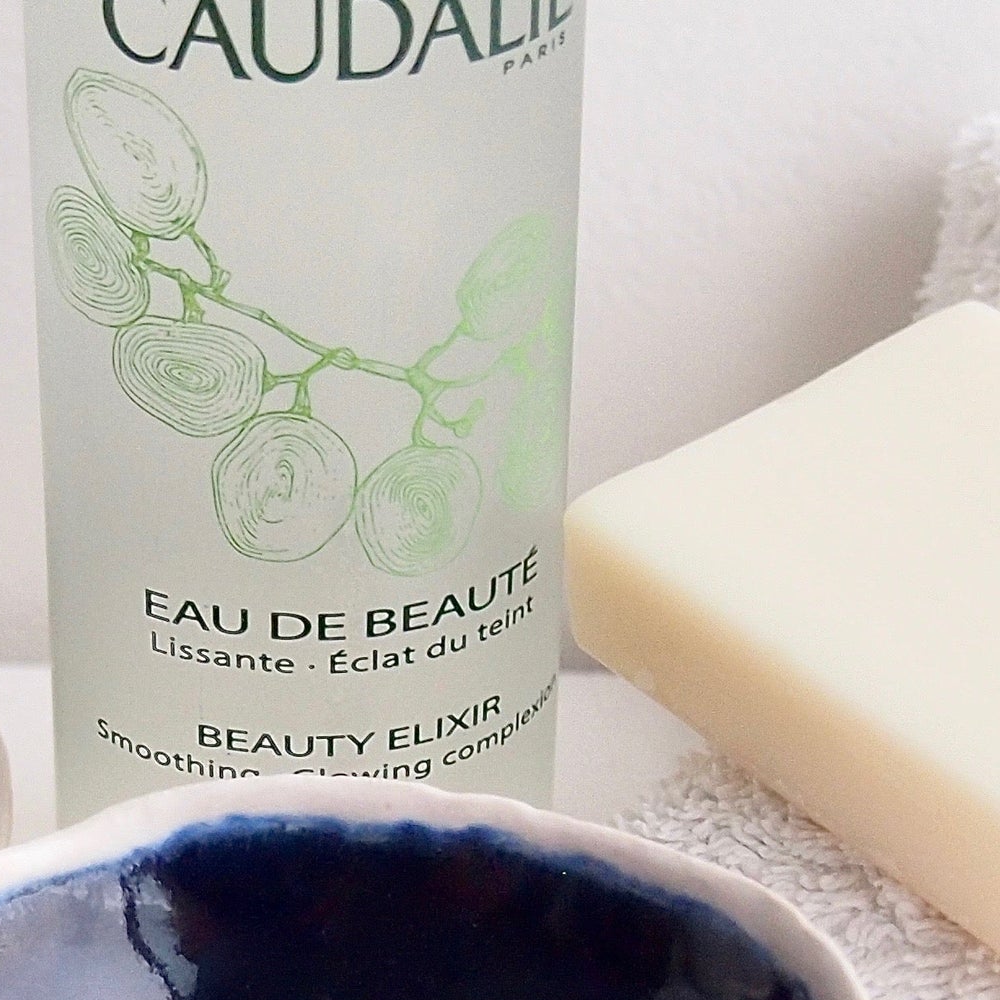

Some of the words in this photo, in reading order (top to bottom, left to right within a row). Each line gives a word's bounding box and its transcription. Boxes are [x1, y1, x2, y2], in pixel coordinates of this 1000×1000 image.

[503, 31, 565, 75] PARIS
[144, 588, 249, 636] EAU
[270, 612, 347, 642] DE
[366, 545, 539, 638] BEAUTÉ
[151, 630, 295, 674] Lissante
[329, 647, 416, 675] Éclat
[426, 634, 467, 659] du
[477, 595, 534, 642] teint
[197, 724, 376, 758] BEAUTY
[388, 695, 501, 751] ELIXIR
